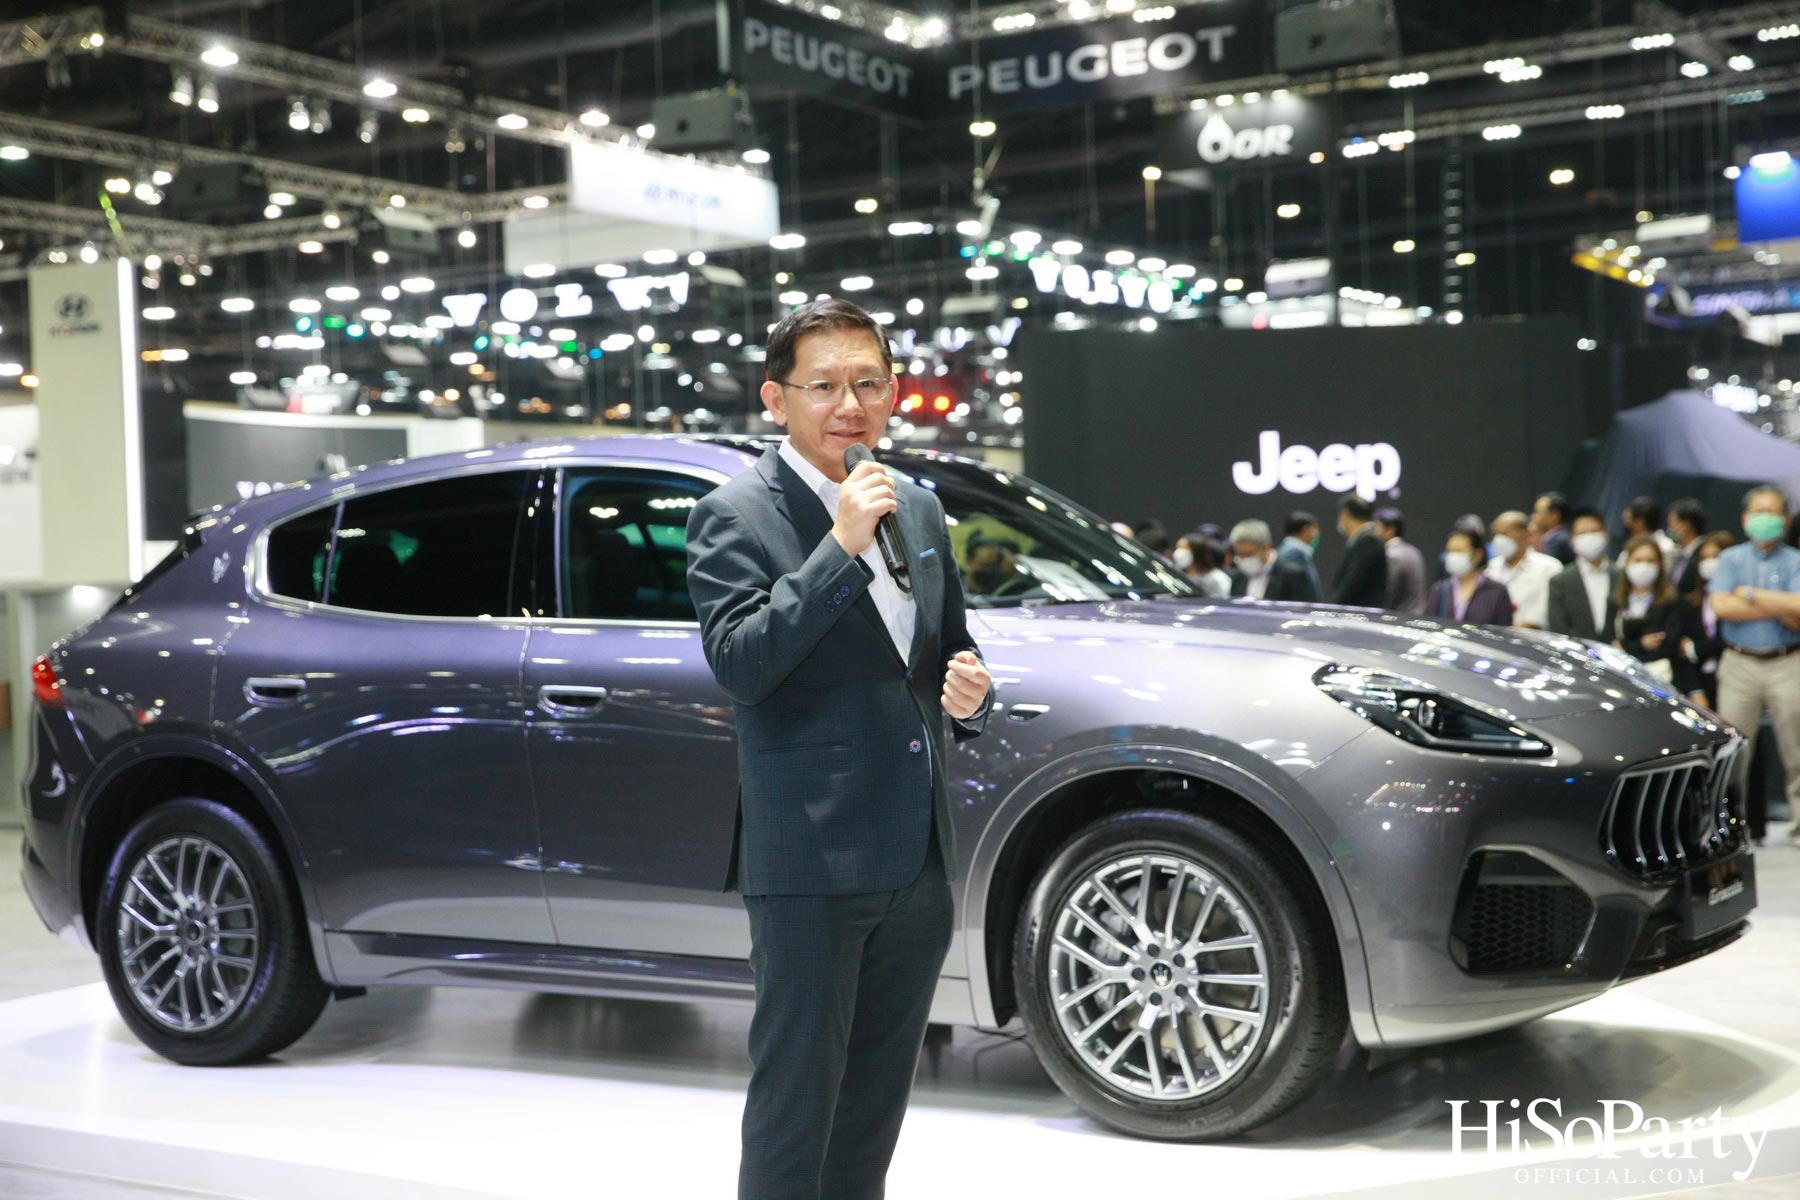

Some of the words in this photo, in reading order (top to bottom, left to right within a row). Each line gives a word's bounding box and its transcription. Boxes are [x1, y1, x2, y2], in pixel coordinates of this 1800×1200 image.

[743, 18, 913, 97] PEUGEOT
[949, 25, 1236, 98] PEUGEOT
[1232, 430, 1402, 503] Jeep
